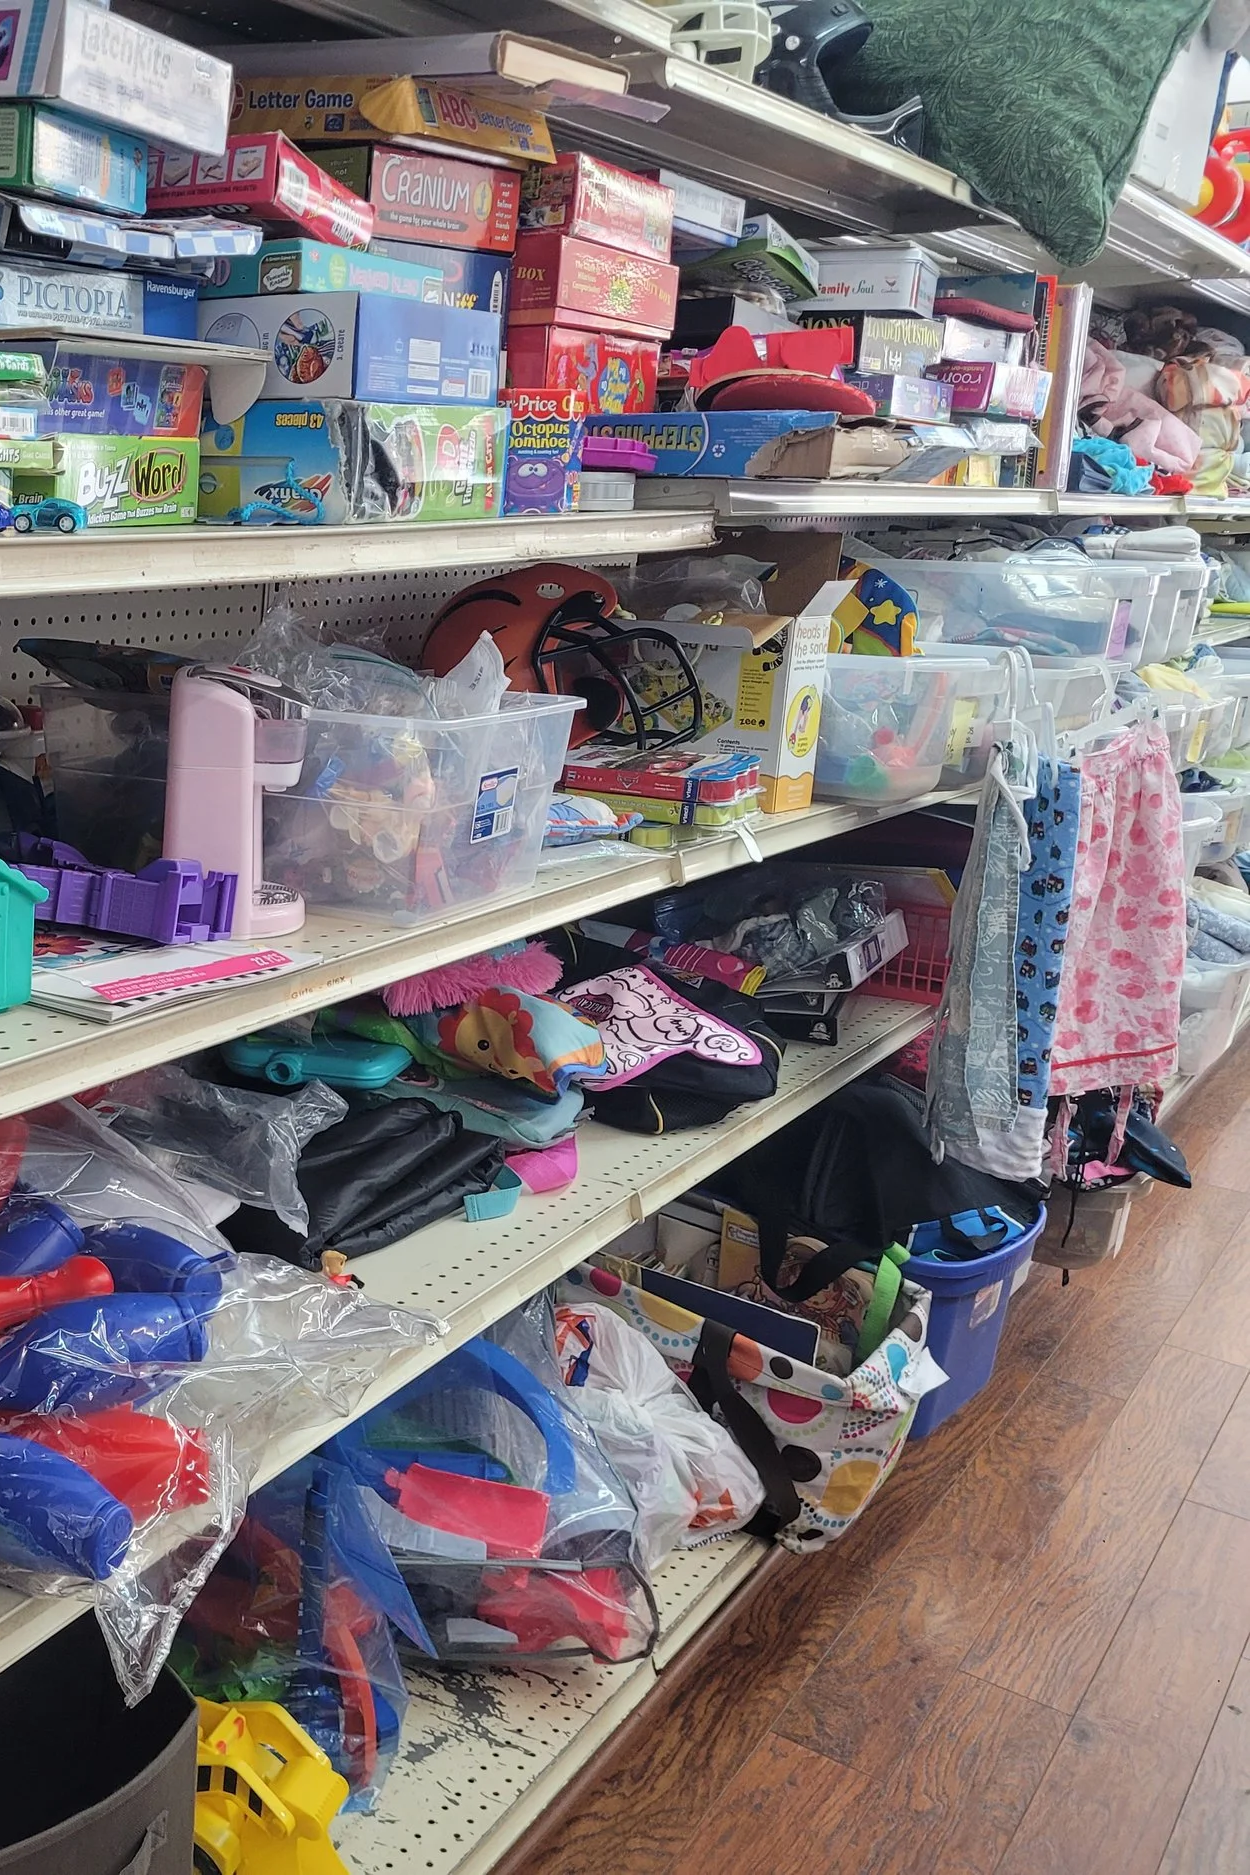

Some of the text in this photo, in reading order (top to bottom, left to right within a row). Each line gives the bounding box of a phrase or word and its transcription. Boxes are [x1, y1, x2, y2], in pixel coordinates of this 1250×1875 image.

[250, 90, 300, 109] Letter
[305, 89, 354, 108] Game
[437, 92, 533, 136] ABC Letter Game
[517, 267, 545, 282] BOX
[146, 281, 196, 299] Ravensburger
[852, 279, 874, 295] Soul
[17, 275, 132, 318] PICTOPIA
[867, 318, 901, 340] LOADED
[6, 358, 30, 372] Cards
[55, 409, 105, 420] other great game!
[275, 412, 324, 429] 43 pieces
[512, 422, 570, 439] Octopus
[135, 453, 185, 498] Word
[19, 493, 44, 505] Brain
[111, 510, 127, 522] Game
[796, 624, 821, 640] heads
[794, 643, 808, 657] the
[717, 737, 740, 745] Contents
[685, 780, 693, 798] vtech
[682, 805, 690, 825] vtech
[251, 952, 285, 968] 22 PCS
